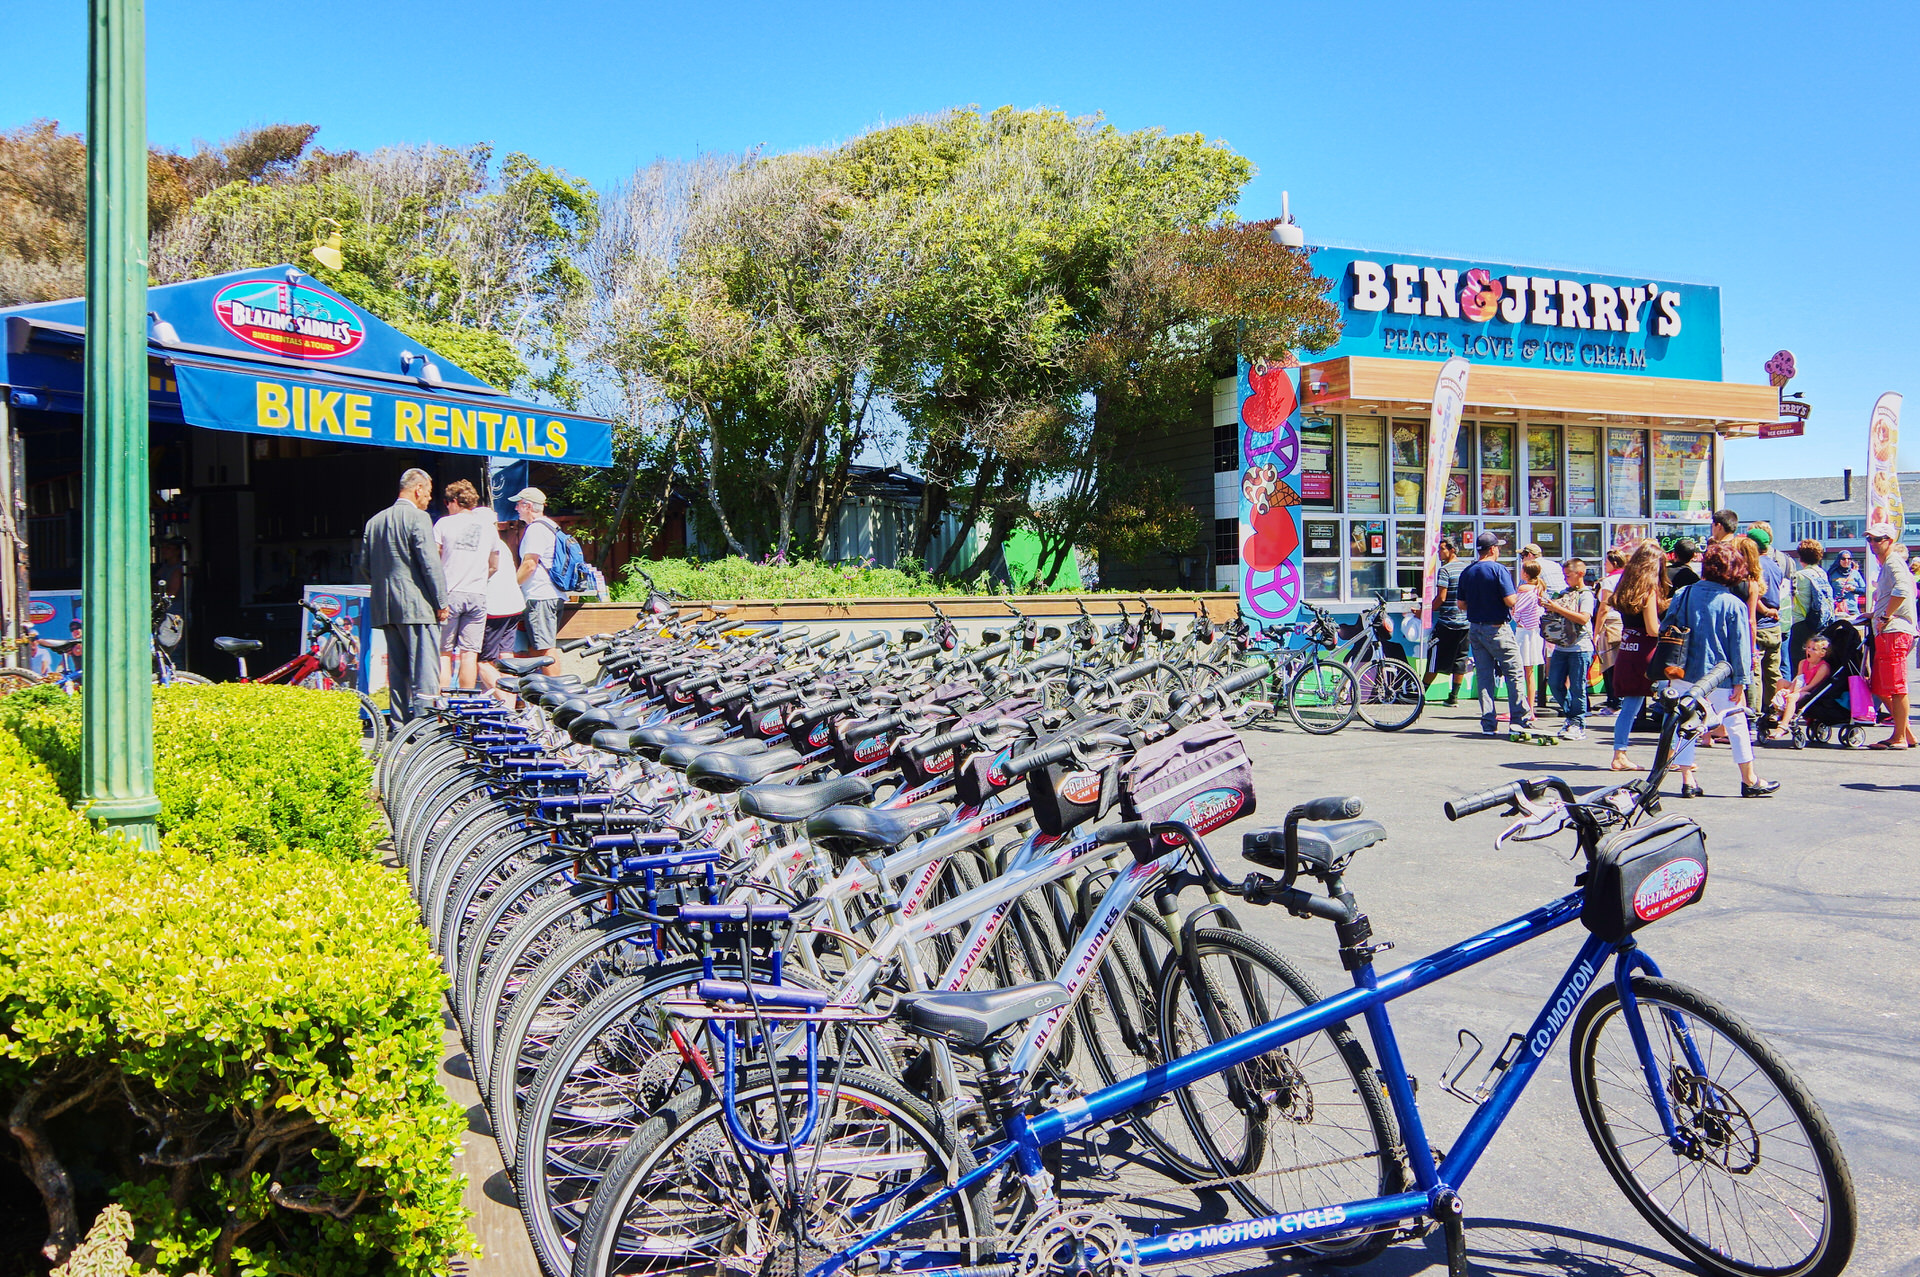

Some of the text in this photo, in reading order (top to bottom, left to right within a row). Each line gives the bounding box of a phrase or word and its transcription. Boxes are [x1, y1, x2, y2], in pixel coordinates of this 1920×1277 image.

[1353, 260, 1682, 337] BEN & JERRY'S
[231, 300, 294, 333] BLAZING
[252, 331, 270, 341] BIKE
[271, 334, 303, 346] RENTALS
[311, 341, 335, 352] TOURS
[1384, 328, 1648, 368] PEACE, LOVE & ICE CREAM
[255, 381, 568, 459] BIKE RENTALS
[1780, 404, 1807, 416] ERRY'S
[928, 748, 954, 770] BLAZIN
[1077, 789, 1091, 800] SAN
[980, 800, 1030, 827] Blazer
[1204, 795, 1238, 821] SADDLES
[1071, 838, 1100, 859] Bla
[1640, 887, 1674, 911] BLAZING
[1645, 891, 1694, 917] SAN FRANCISCO
[948, 900, 1011, 992] BLAZING SADD
[1075, 905, 1121, 978] SADDLES
[1280, 1206, 1347, 1233] CYCLES
